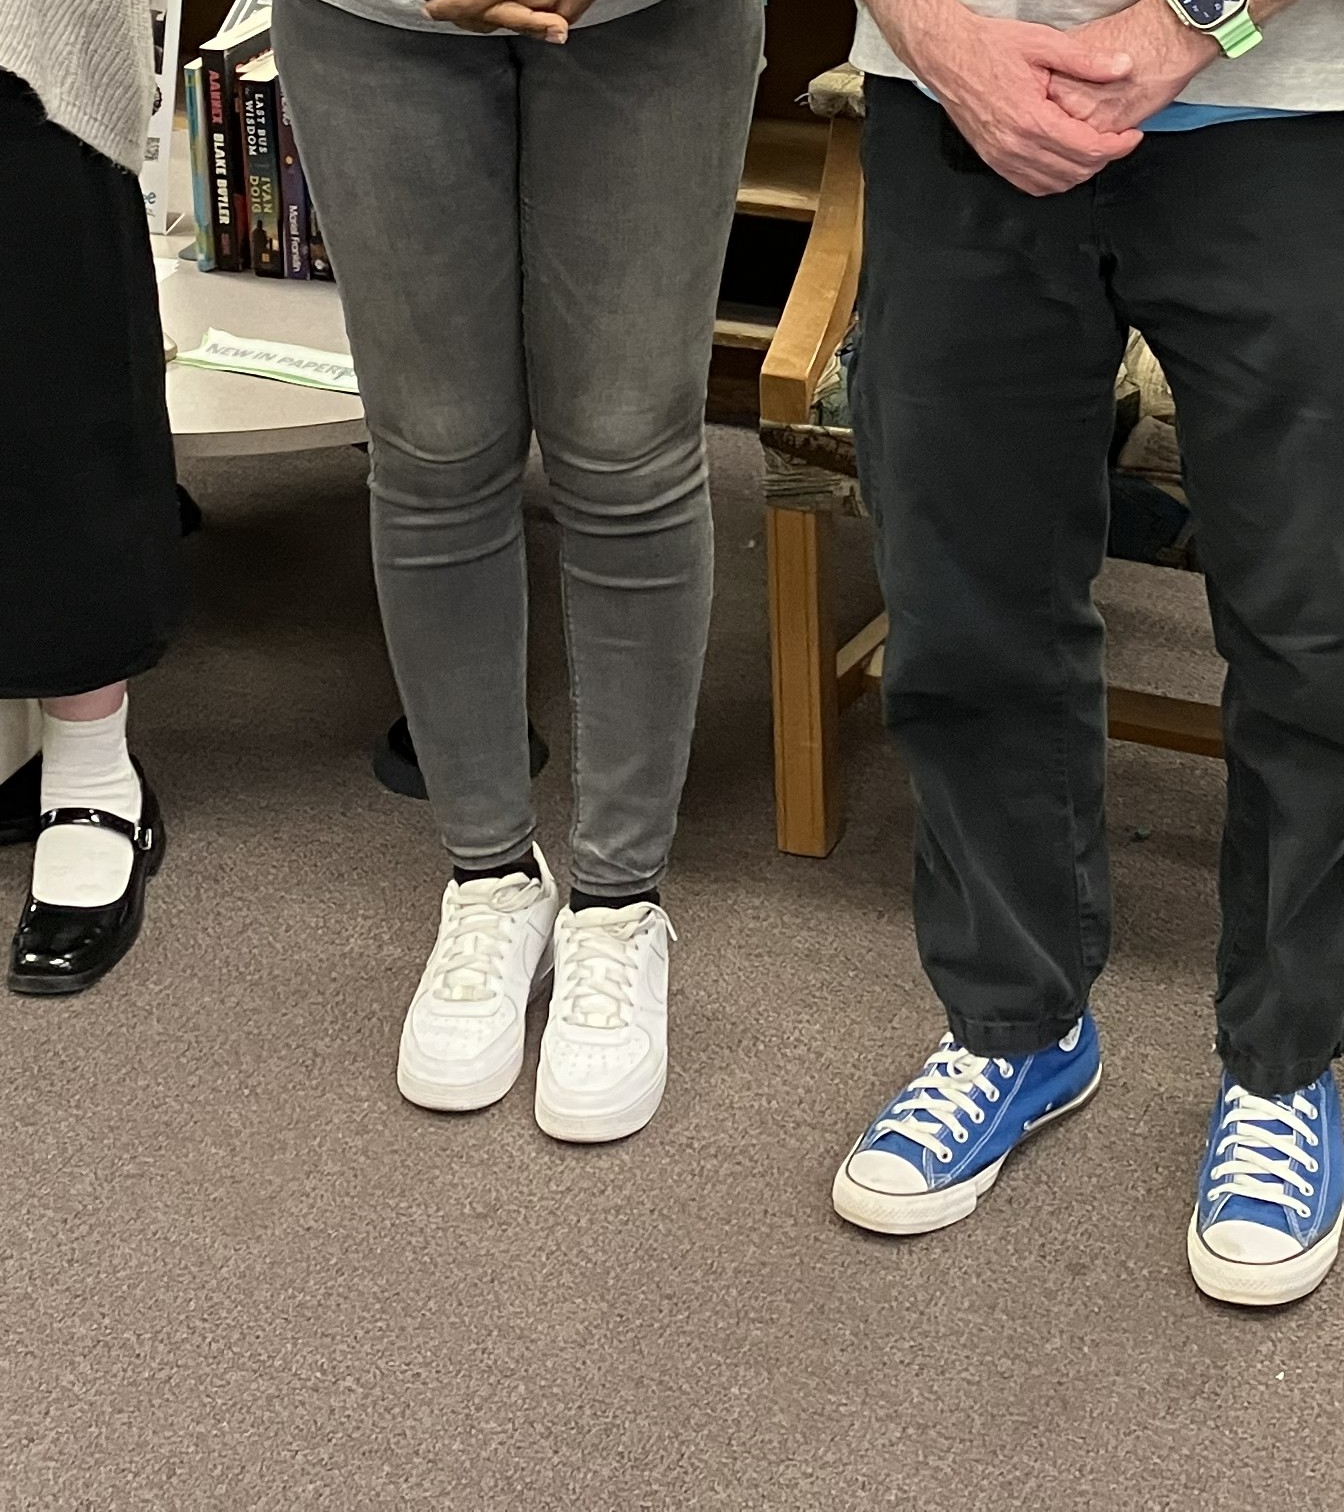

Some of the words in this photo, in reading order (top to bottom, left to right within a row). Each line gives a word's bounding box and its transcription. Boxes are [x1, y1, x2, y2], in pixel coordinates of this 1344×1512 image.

[245, 99, 258, 156] WISDOM
[254, 92, 267, 125] LAST
[213, 132, 227, 176] BLAKE
[257, 128, 268, 154] BUS
[216, 177, 230, 226] BUTLER
[249, 174, 262, 214] DOIG
[261, 175, 273, 214] IVAN
[206, 342, 254, 358] NEW
[254, 351, 277, 361] IN
